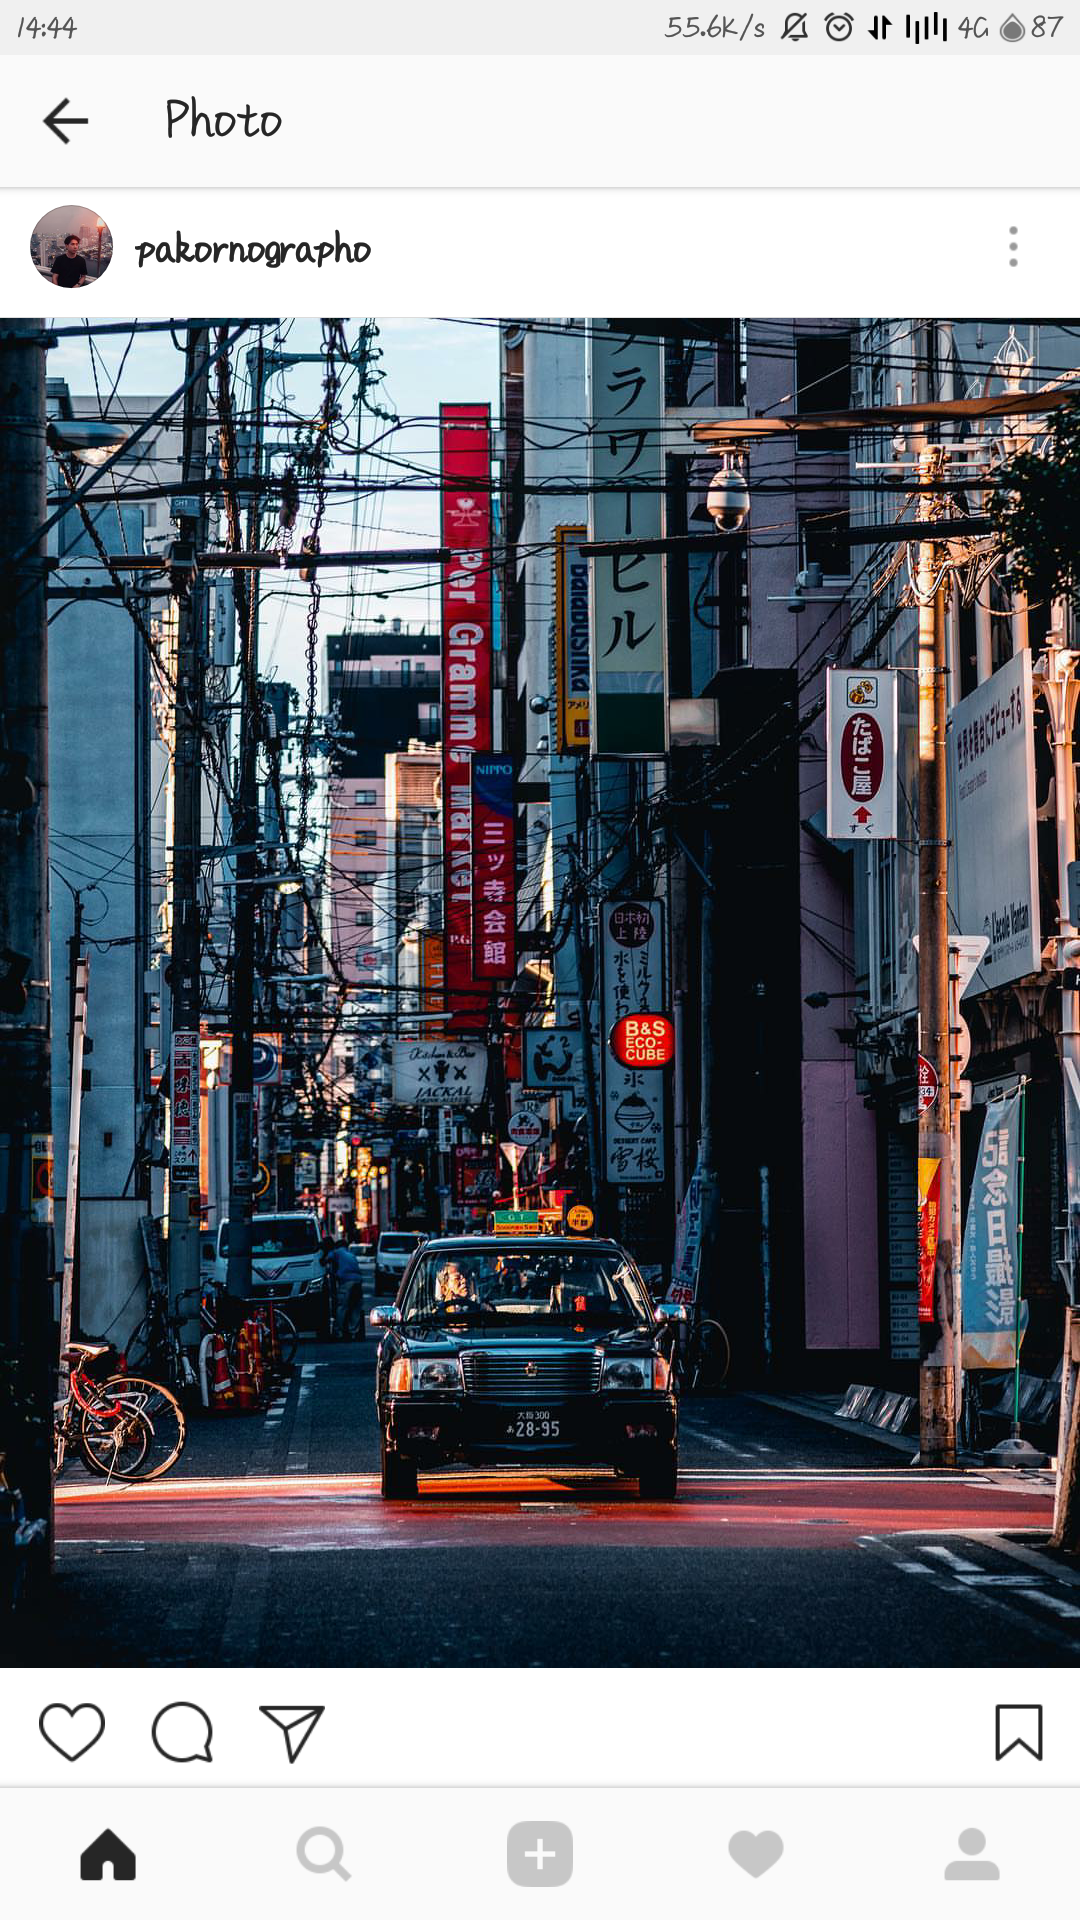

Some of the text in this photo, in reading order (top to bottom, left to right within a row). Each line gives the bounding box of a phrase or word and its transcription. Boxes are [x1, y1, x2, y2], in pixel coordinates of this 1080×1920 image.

[18, 17, 77, 39] 14:44
[665, 13, 764, 41] 55.6K/s
[958, 17, 988, 39] 4G
[1030, 16, 1064, 37] 87
[165, 96, 282, 138] Photo
[135, 230, 371, 268] pakornographo
[447, 551, 484, 604] Per
[448, 622, 484, 763] Gramme
[851, 717, 873, 797] たばこ屋
[475, 764, 513, 775] NIPPO
[849, 823, 874, 834] すぐ
[613, 911, 650, 925] 日本初
[615, 926, 649, 940] 上陸
[626, 1021, 665, 1037] B&S
[626, 1038, 662, 1048] ECO-
[626, 1049, 665, 1061] CUBE
[414, 1086, 473, 1098] JACKAL
[535, 1411, 550, 1420] 300
[516, 1421, 560, 1437] 28-95
